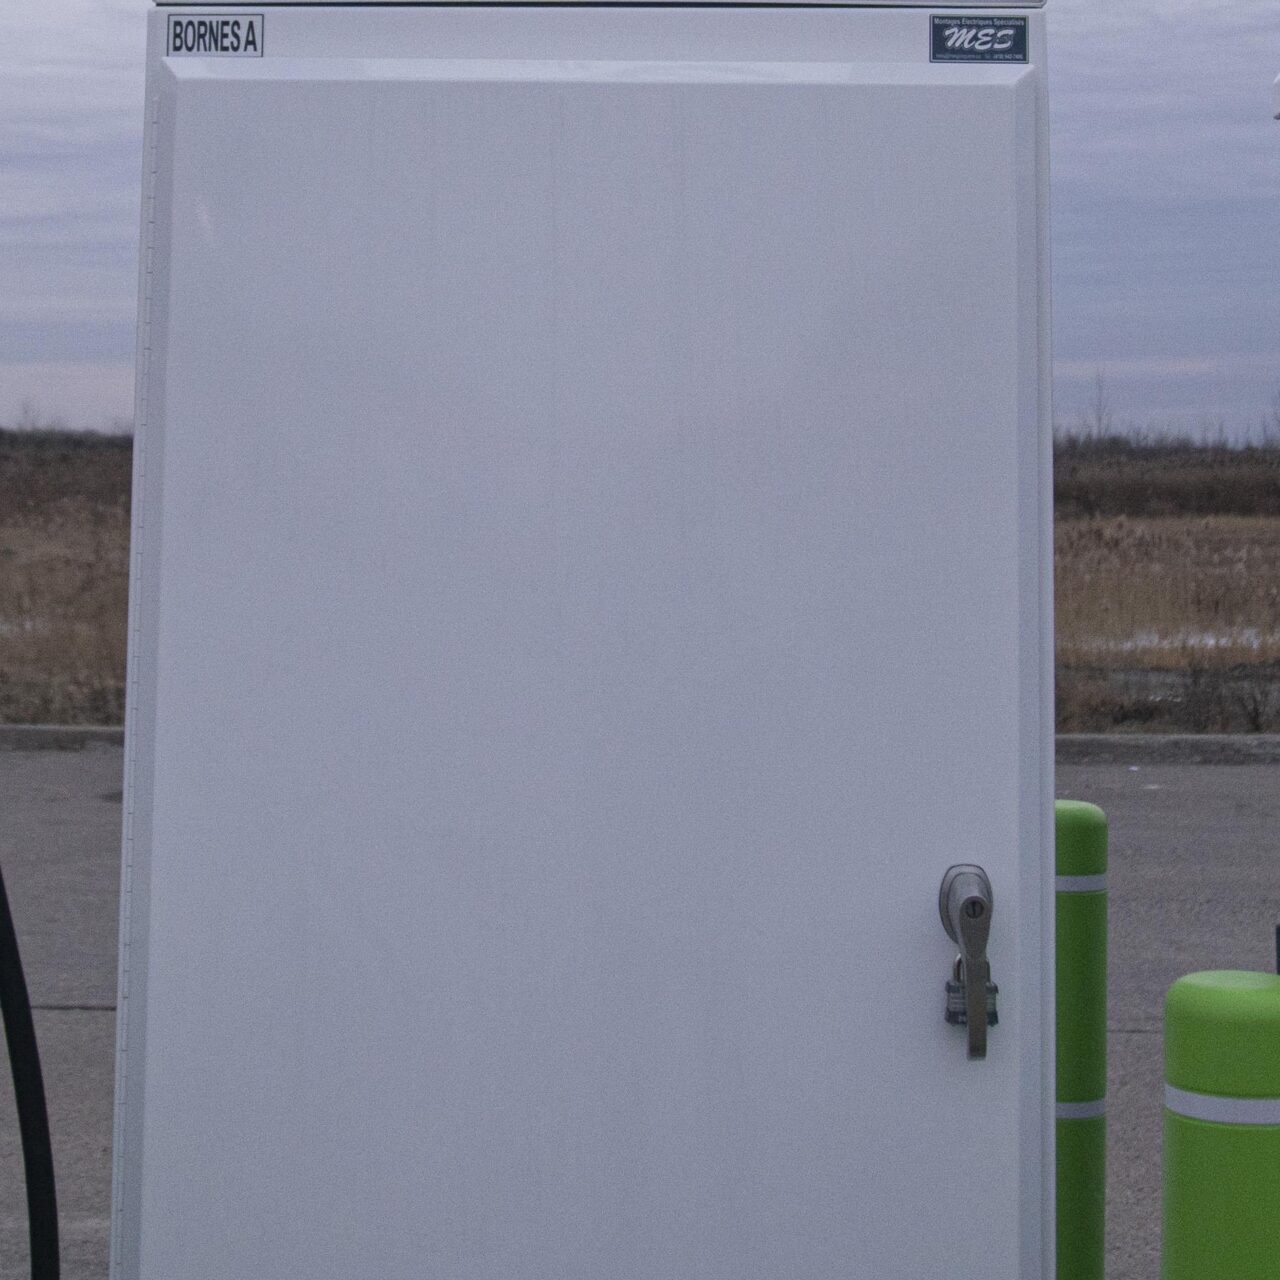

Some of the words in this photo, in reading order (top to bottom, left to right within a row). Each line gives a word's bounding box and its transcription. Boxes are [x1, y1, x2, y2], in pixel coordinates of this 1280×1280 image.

[172, 20, 241, 52] BORNES
[243, 20, 258, 52] A
[944, 27, 1014, 50] MES
